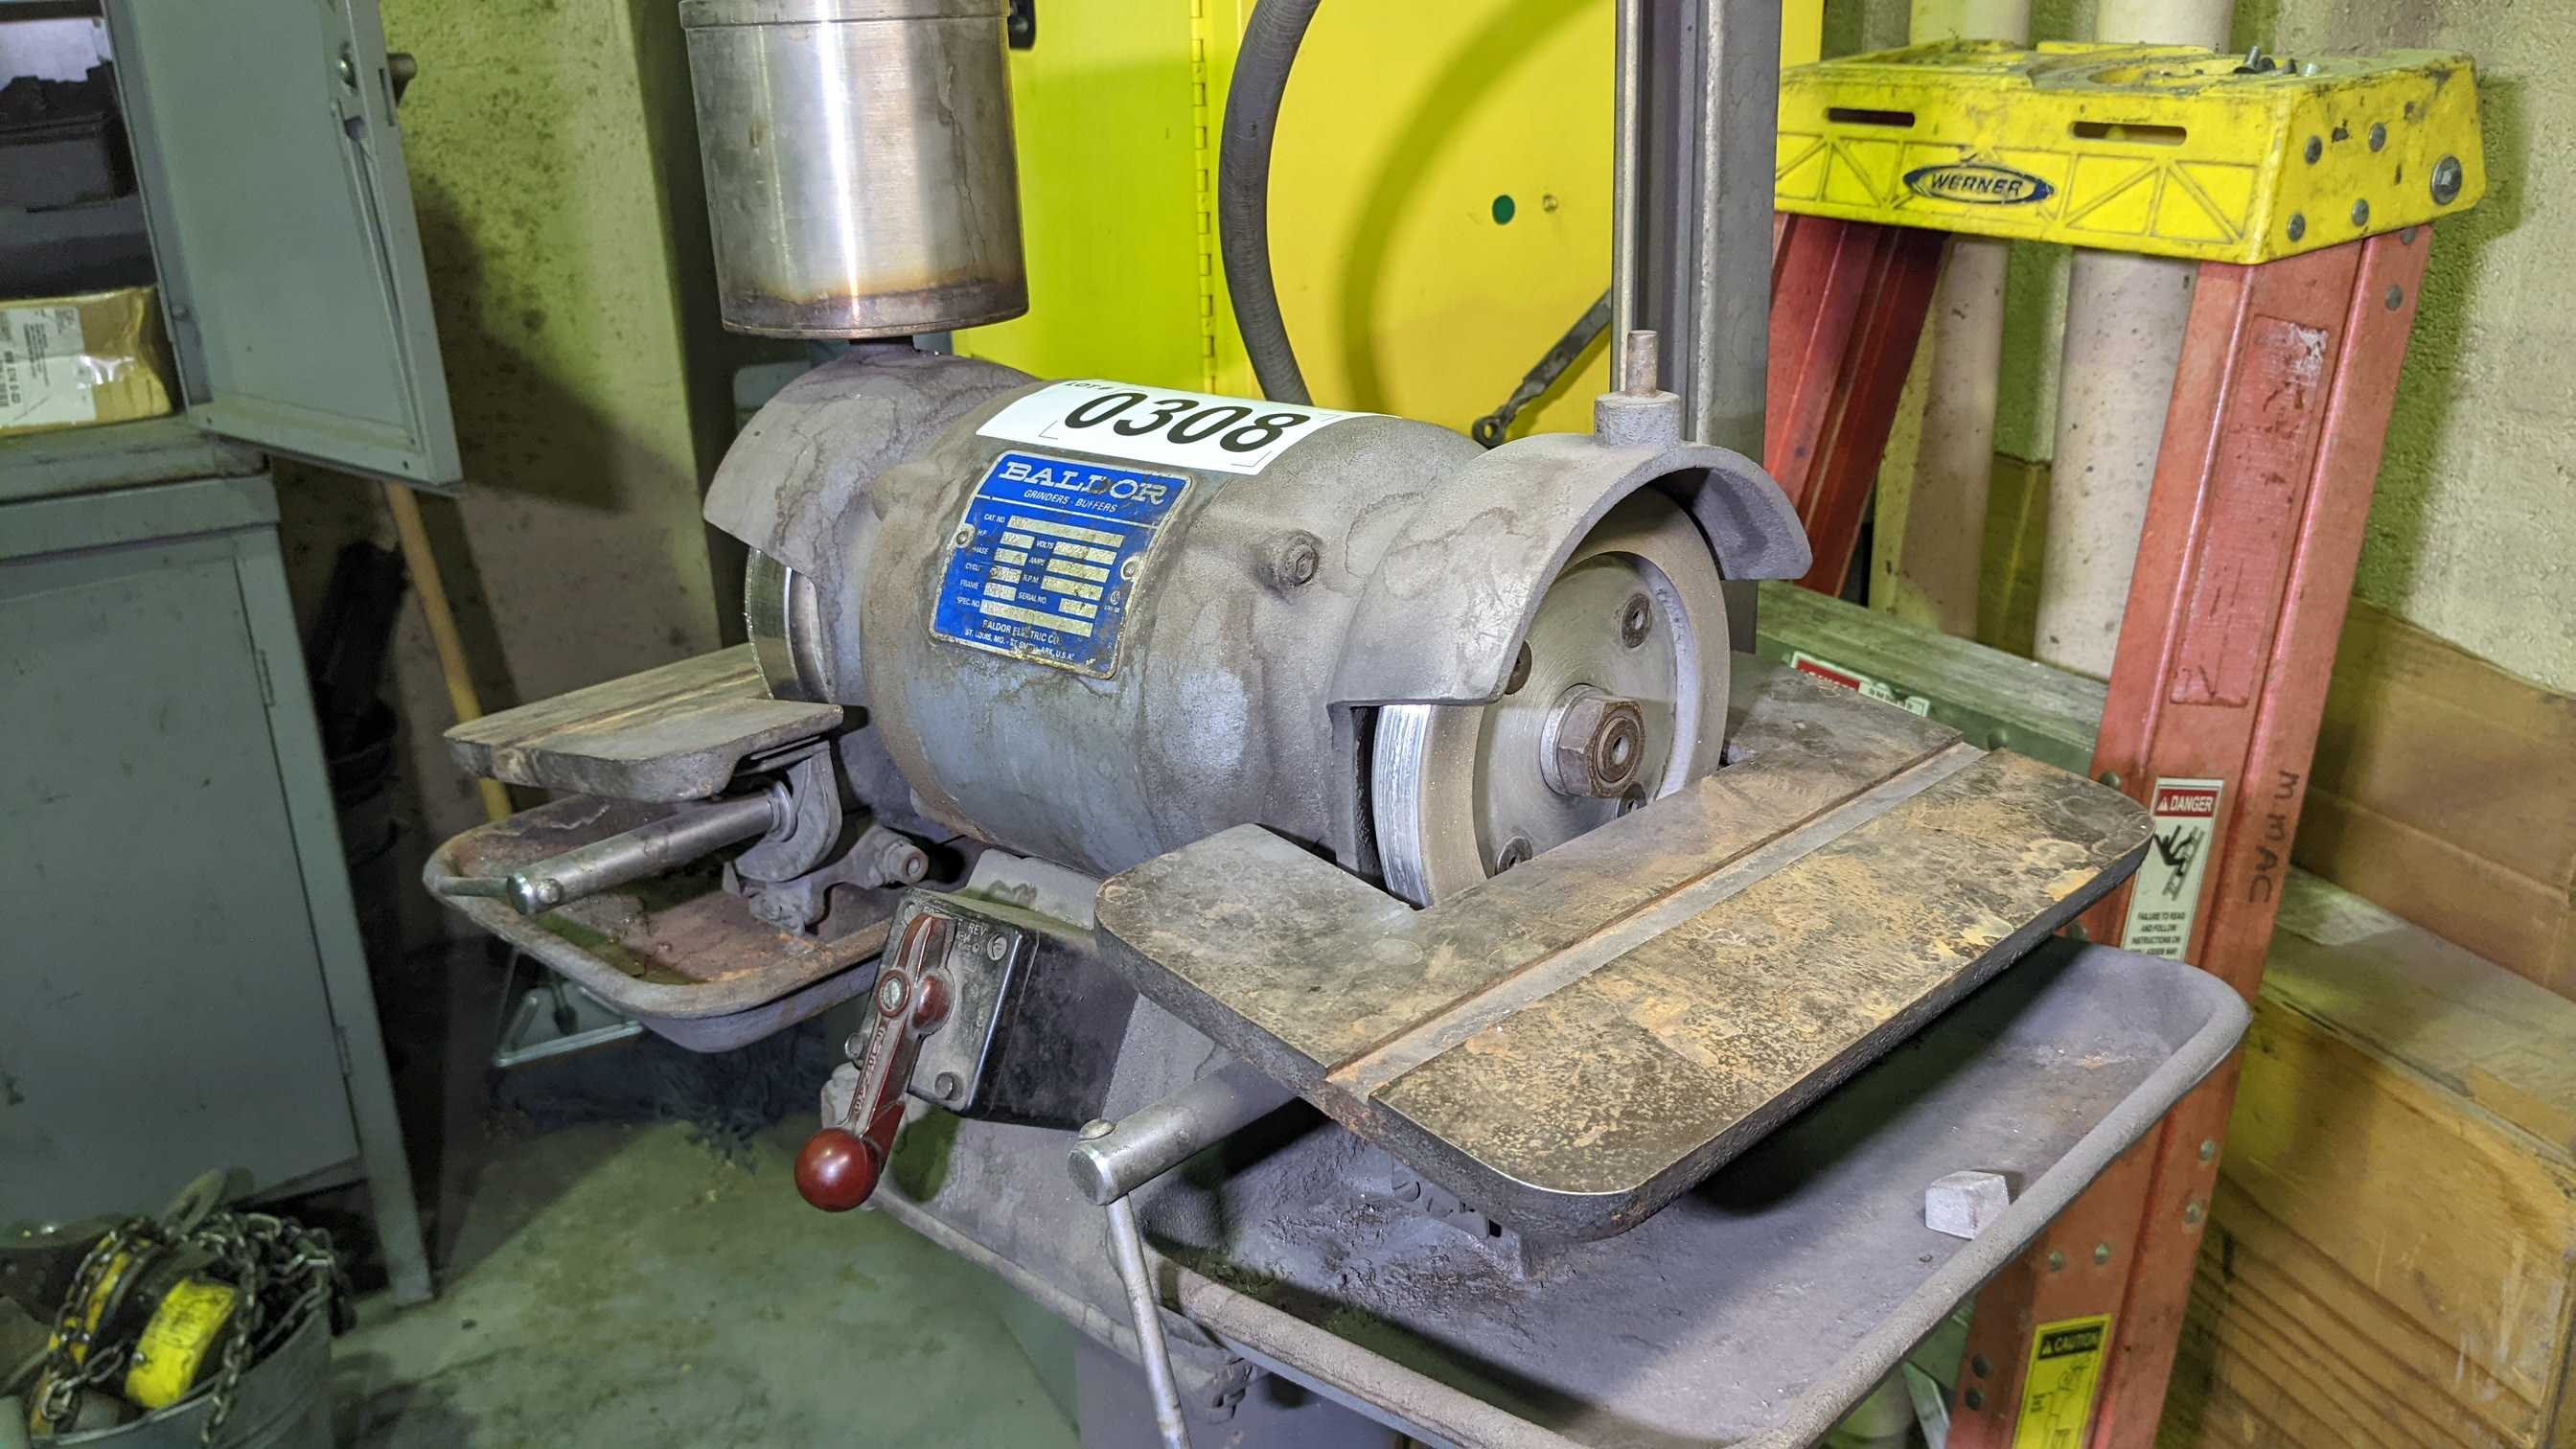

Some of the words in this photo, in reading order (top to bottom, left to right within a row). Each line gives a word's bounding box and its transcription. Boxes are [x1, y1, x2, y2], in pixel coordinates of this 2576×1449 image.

[1931, 173, 2023, 196] WERNER
[1064, 392, 1312, 452] 0308
[998, 461, 1168, 506] BALDOR
[1024, 489, 1070, 505] GRINDERS
[1075, 497, 1118, 514] BUFFERS
[2169, 794, 2215, 813] DANGER
